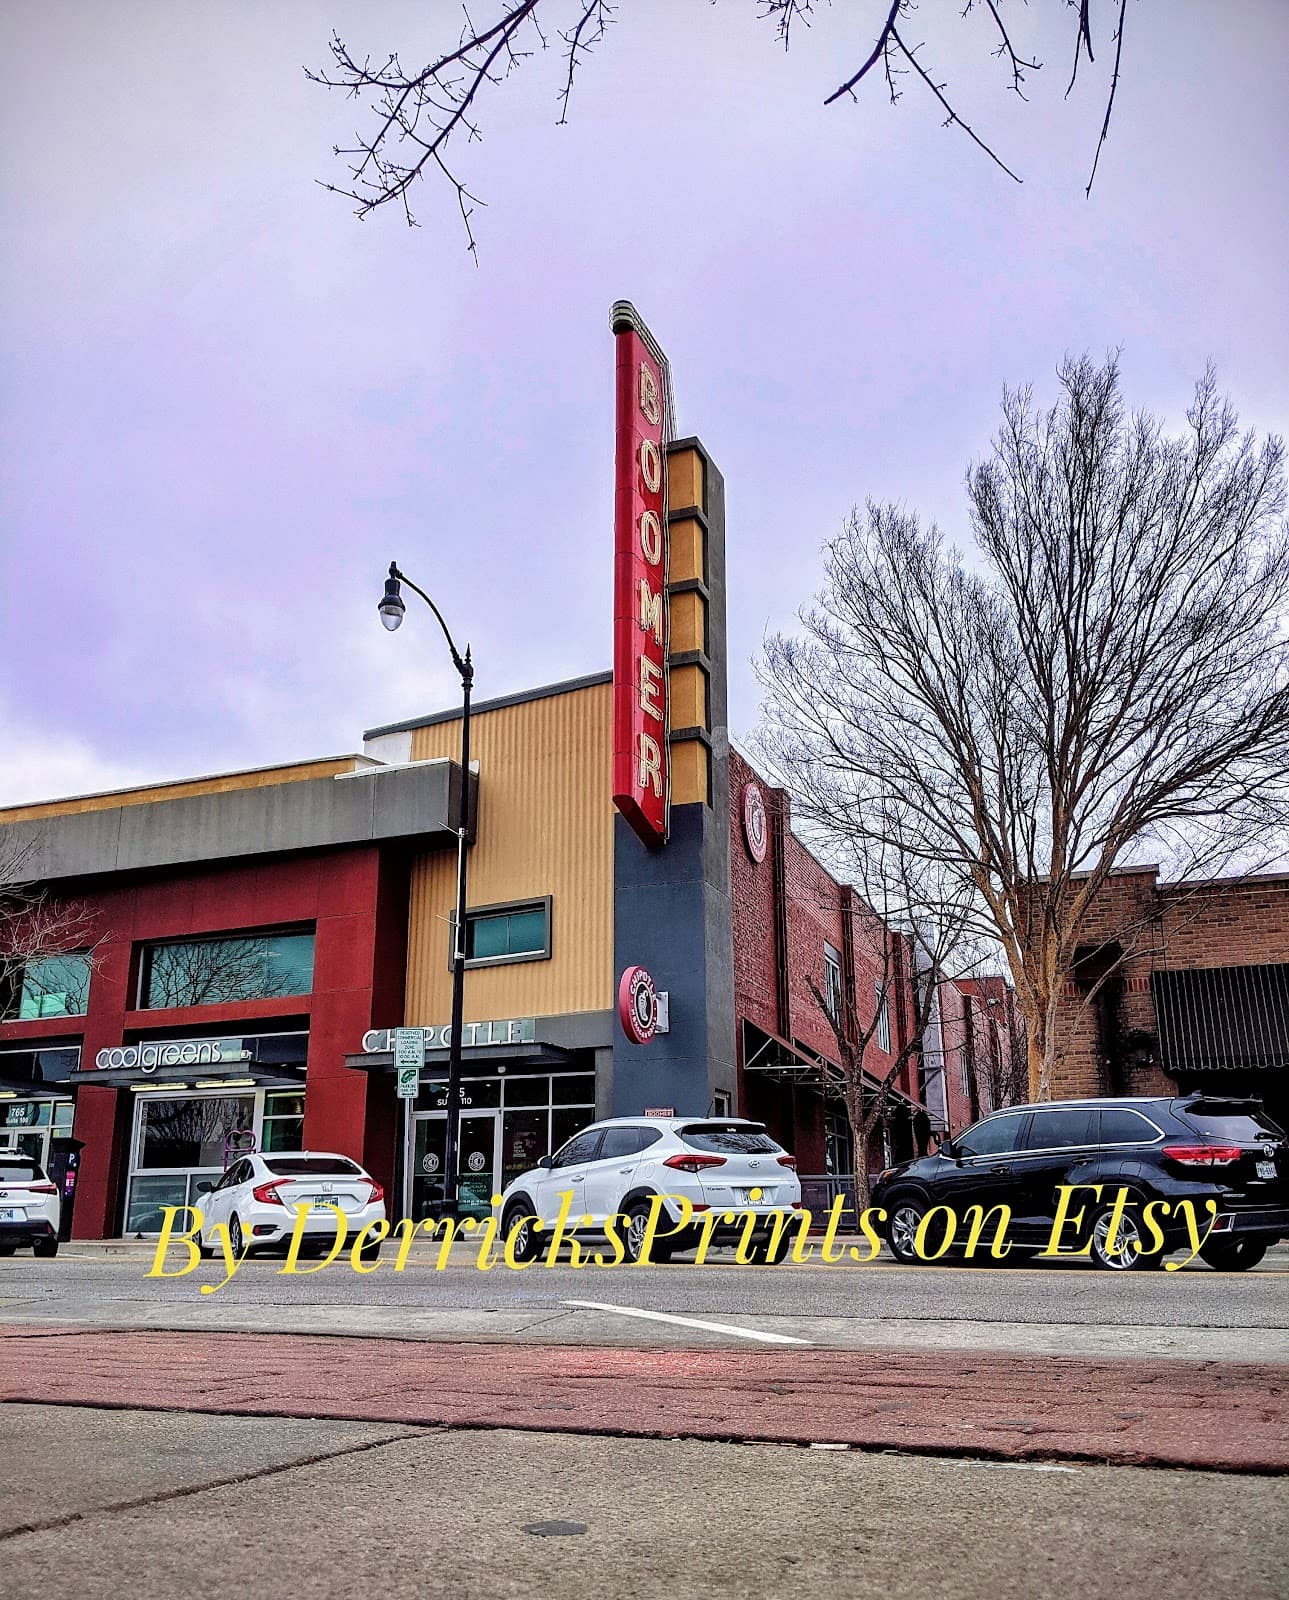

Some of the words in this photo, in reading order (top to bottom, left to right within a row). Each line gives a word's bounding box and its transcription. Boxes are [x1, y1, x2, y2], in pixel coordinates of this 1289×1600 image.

[637, 360, 663, 799] BOOMER
[361, 1020, 535, 1053] CHPOTLE
[95, 1040, 223, 1074] coolgreens
[11, 1107, 25, 1117] 765
